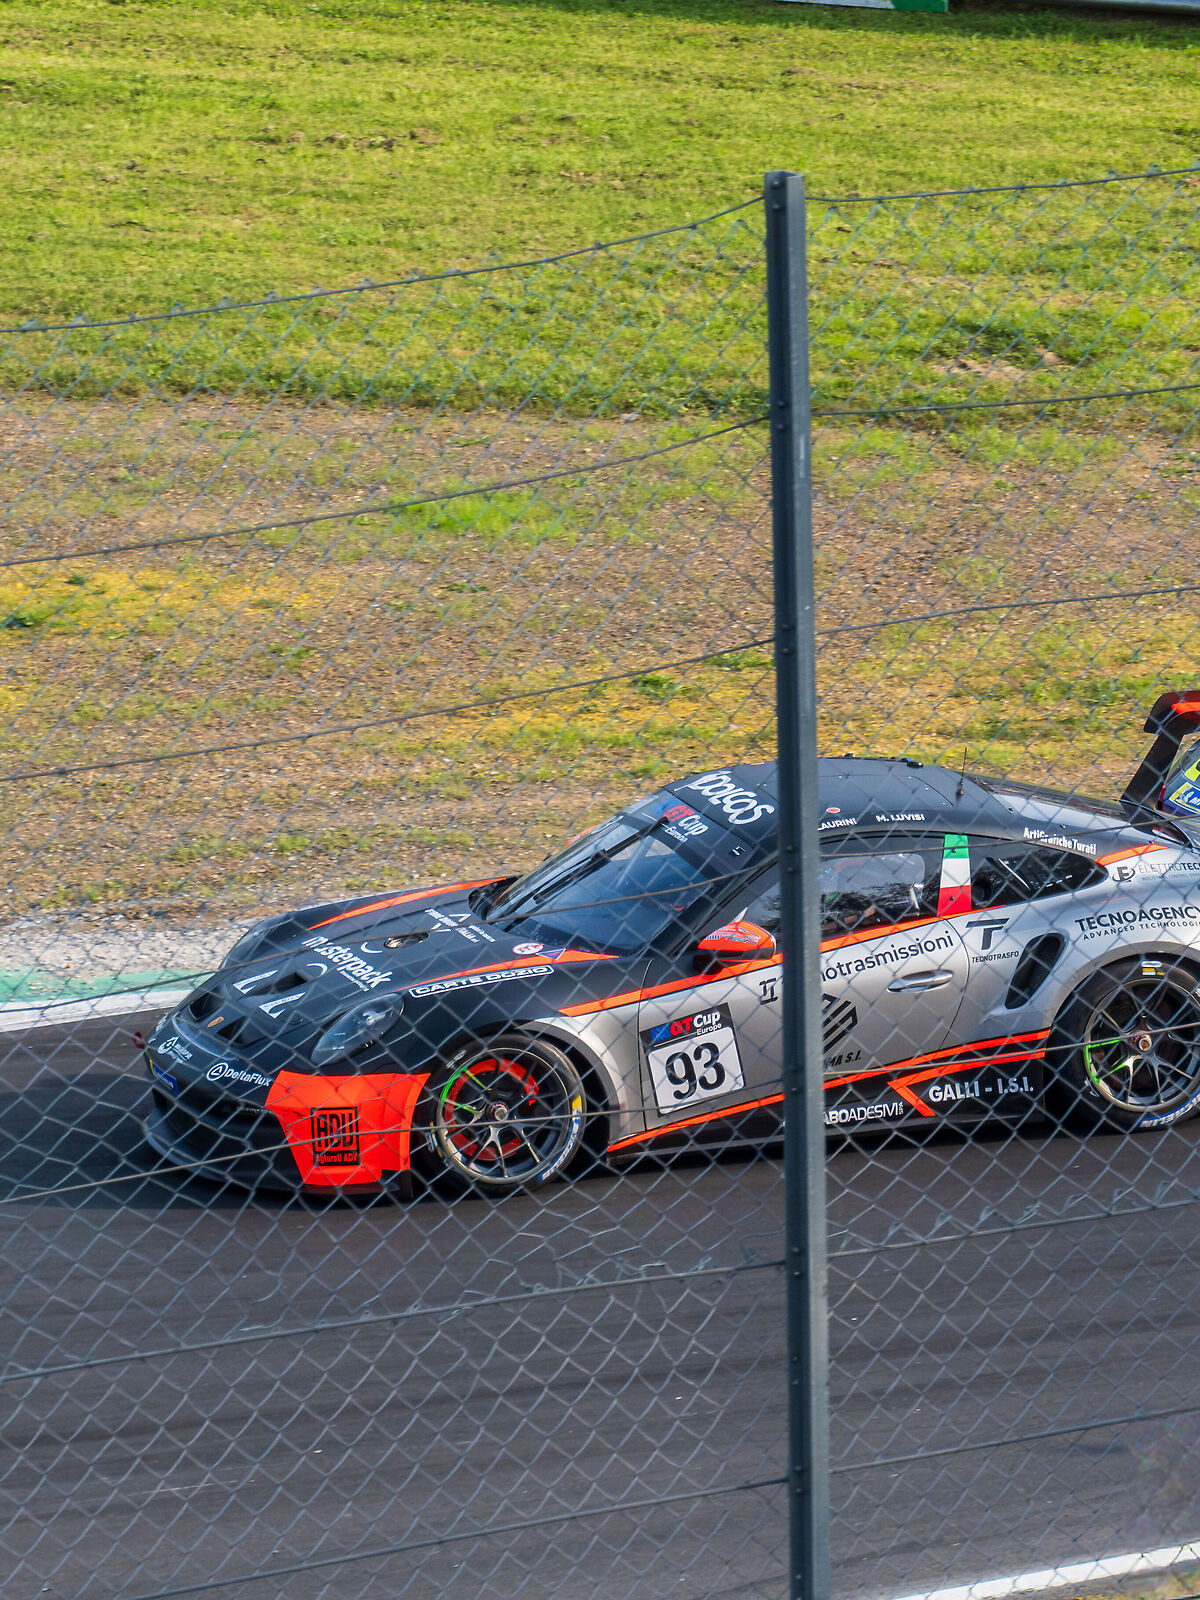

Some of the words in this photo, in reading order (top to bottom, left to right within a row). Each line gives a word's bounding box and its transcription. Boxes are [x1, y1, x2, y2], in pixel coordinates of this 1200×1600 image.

[662, 804, 696, 822] GT
[817, 817, 858, 831] AURINI
[875, 815, 890, 823] M.
[891, 813, 925, 822] LUVISI
[678, 814, 709, 836] Cup
[1083, 925, 1136, 941] ADVANCED
[971, 950, 1020, 963] TECNOTRASFO
[415, 976, 483, 995] CARTE
[484, 966, 549, 981] DOZIO
[670, 1016, 694, 1036] GT
[692, 1010, 721, 1028] Cup
[696, 1021, 722, 1036] Europe
[224, 1067, 273, 1087] DeltaFlux
[665, 1042, 726, 1100] 93
[929, 1081, 980, 1103] GALLI
[996, 1077, 1034, 1095] I.S.I.
